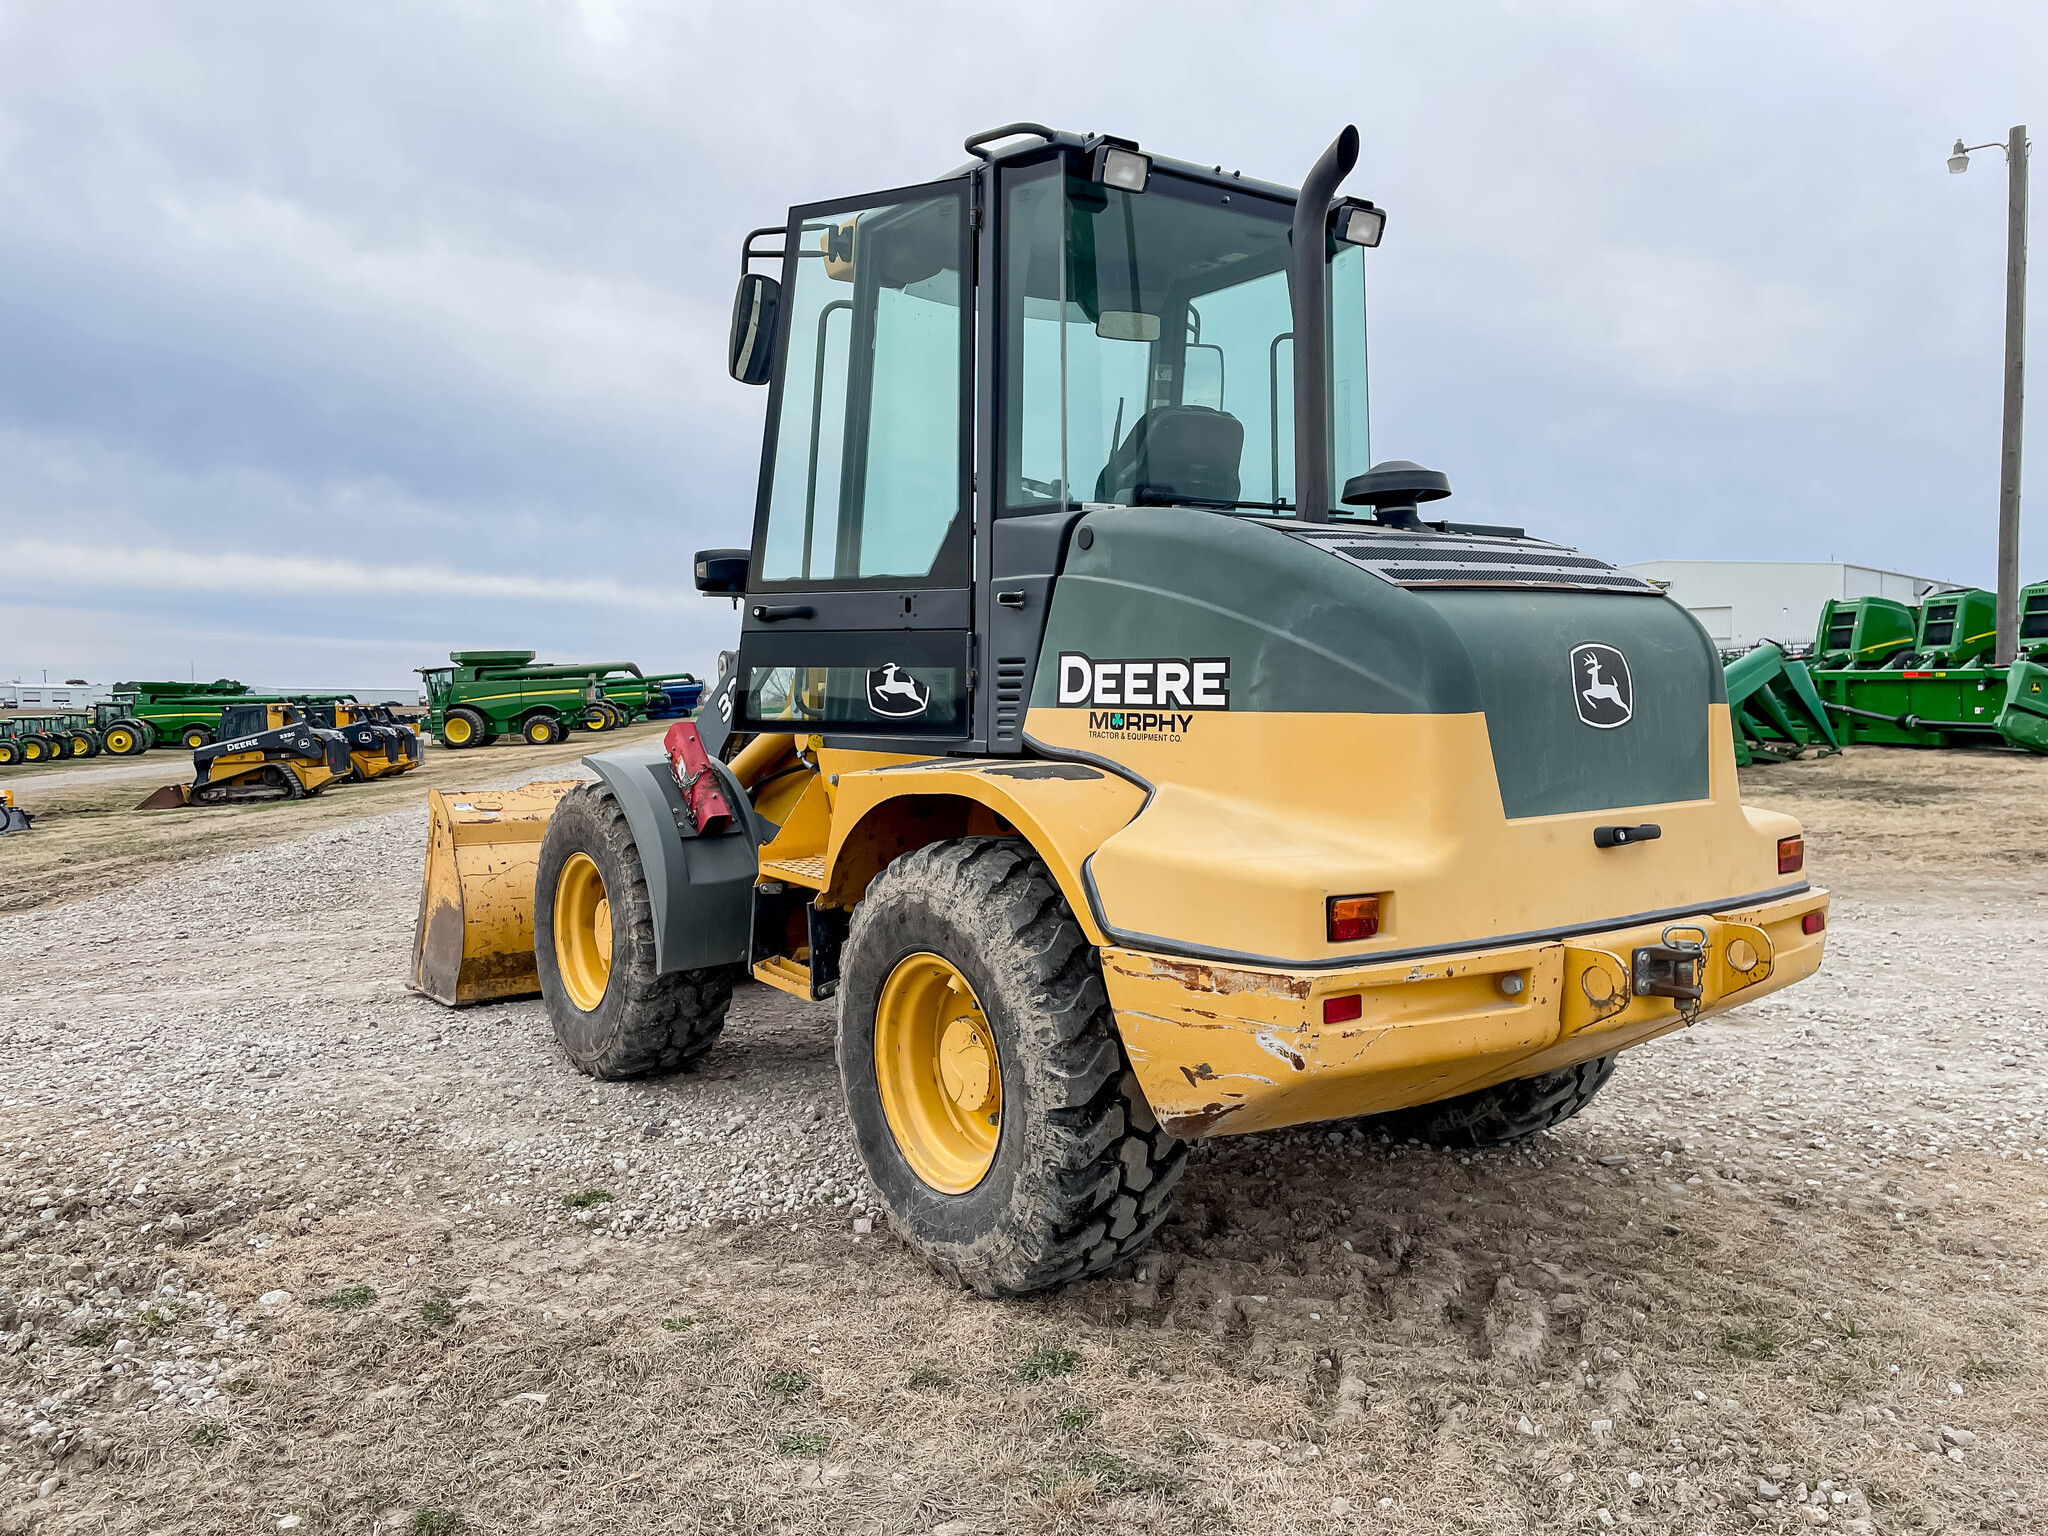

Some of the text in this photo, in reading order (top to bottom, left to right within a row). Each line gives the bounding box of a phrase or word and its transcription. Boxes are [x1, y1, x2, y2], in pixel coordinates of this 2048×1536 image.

[1059, 655, 1226, 705] DEERE
[1089, 712, 1193, 733] MURPHY
[1089, 731, 1182, 742] TRACTOR & EQUIPMENT CO.
[227, 739, 259, 751] DEERE
